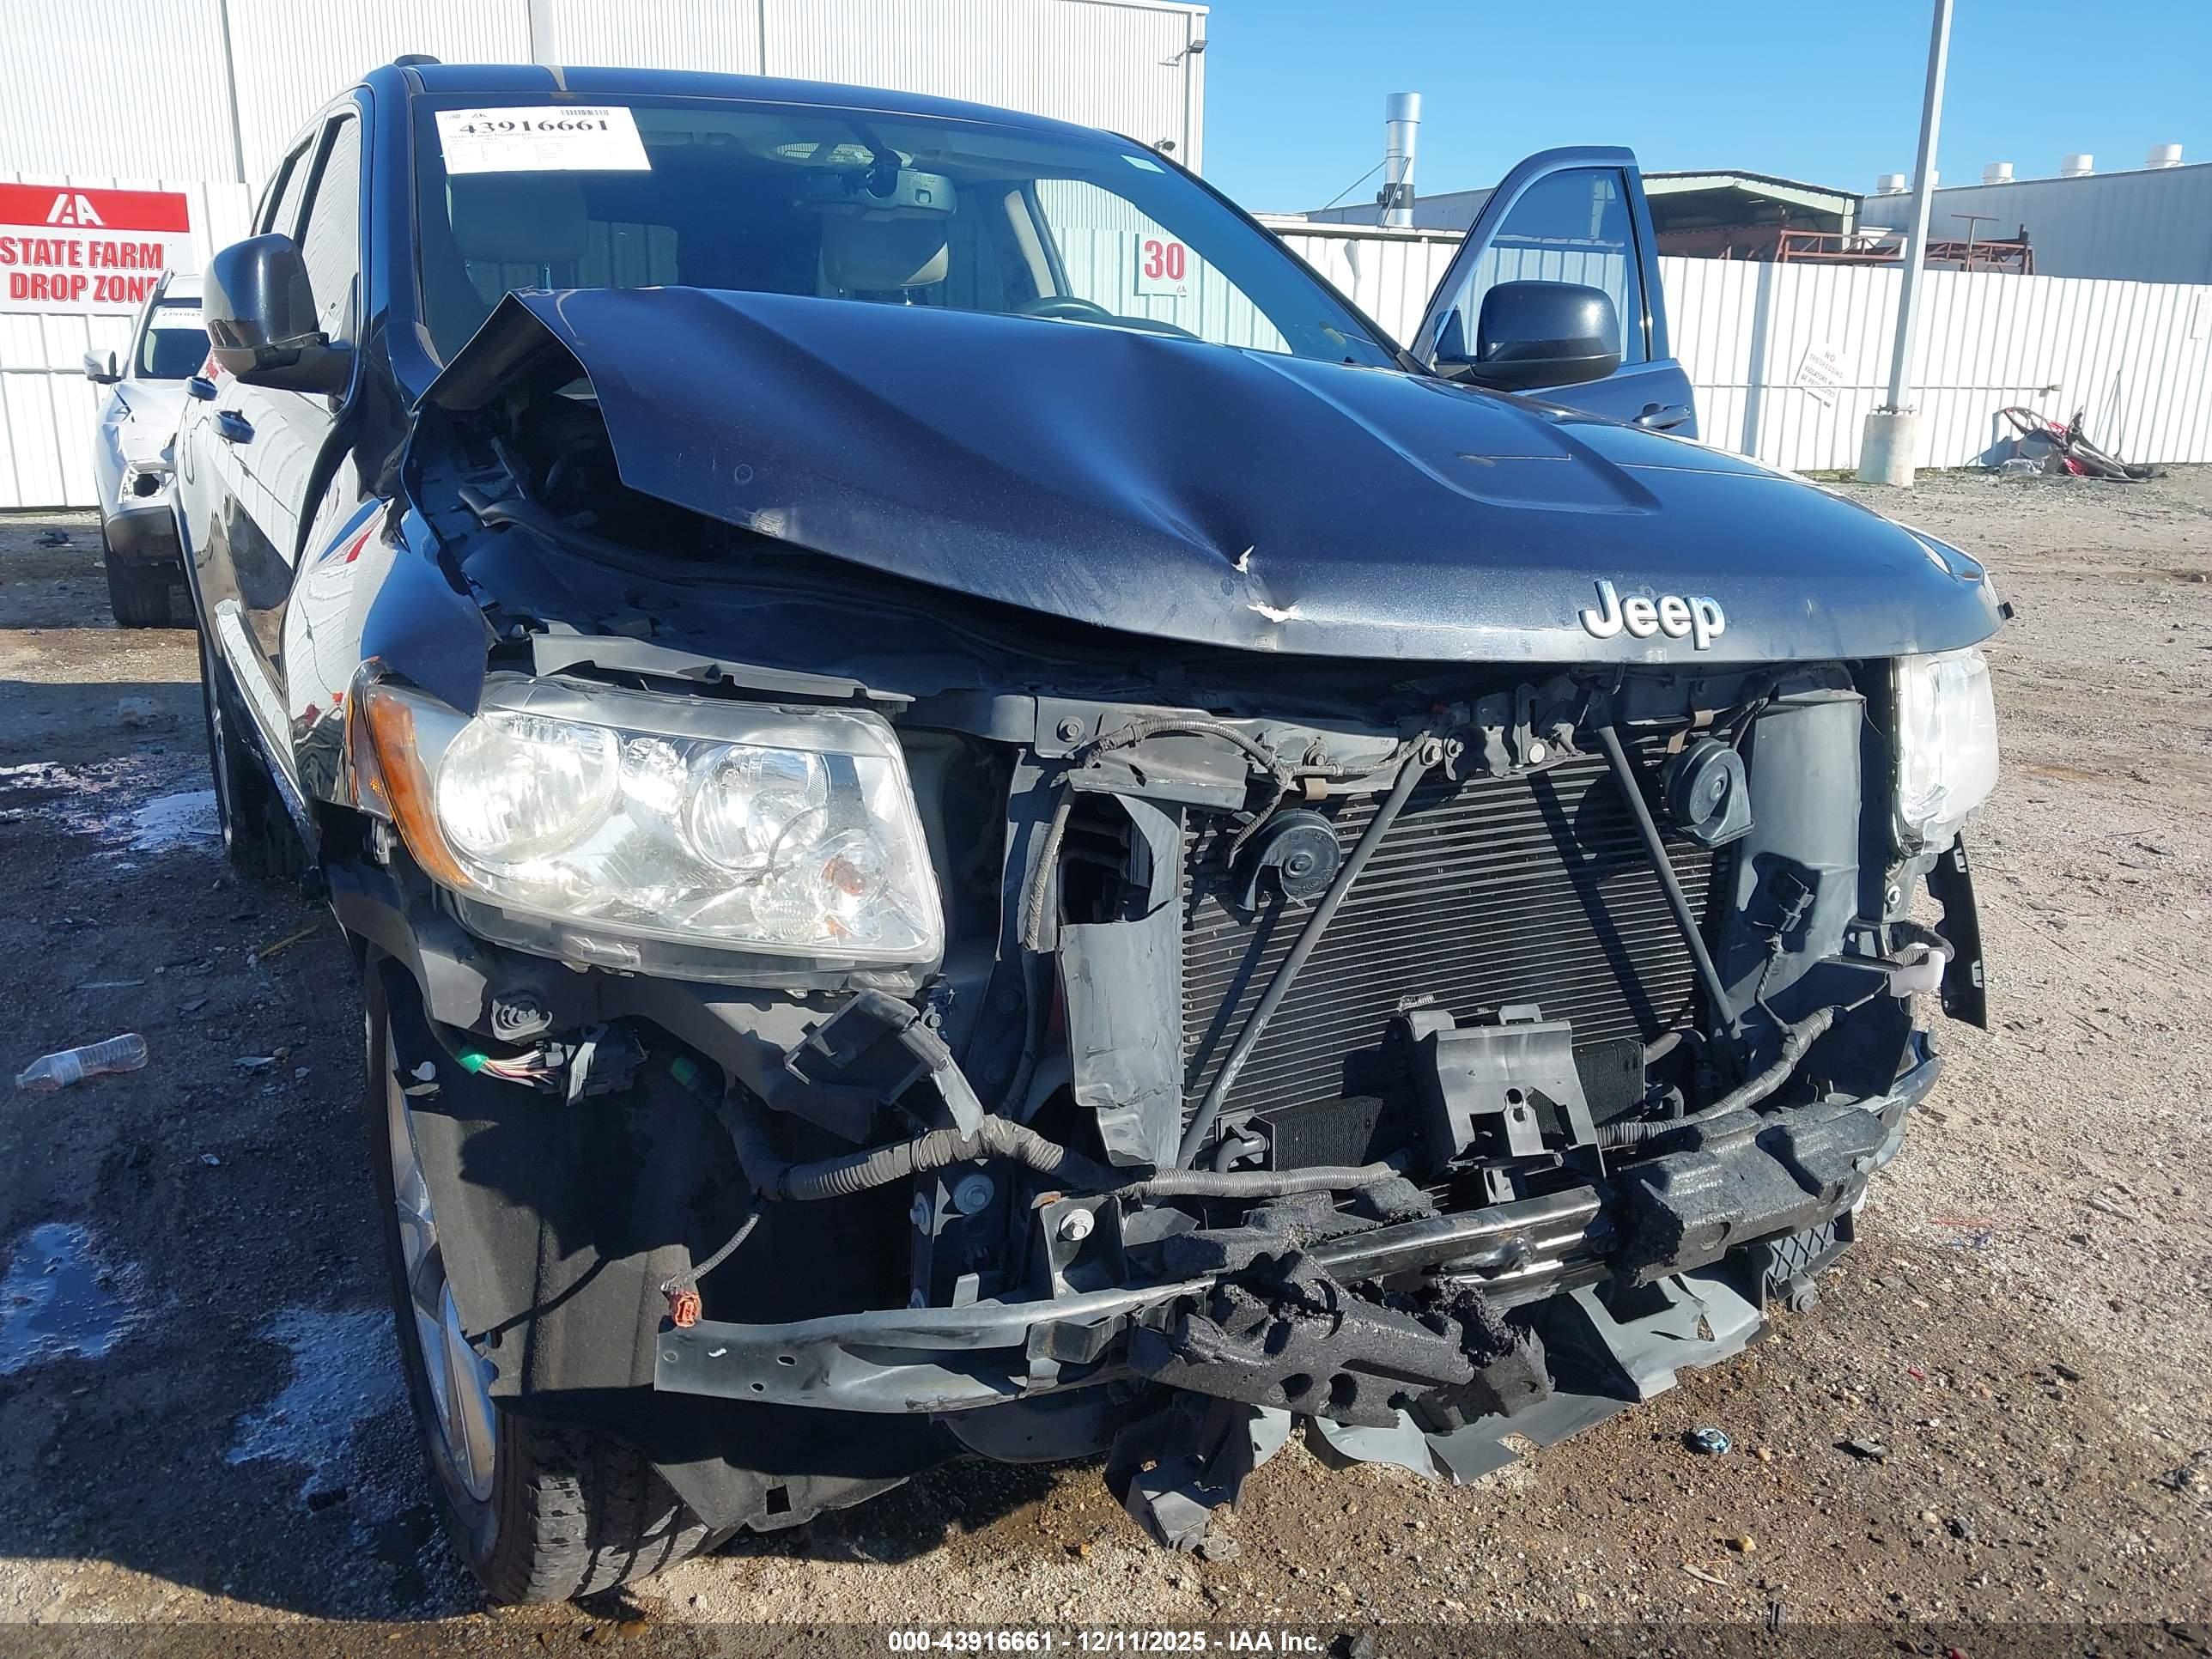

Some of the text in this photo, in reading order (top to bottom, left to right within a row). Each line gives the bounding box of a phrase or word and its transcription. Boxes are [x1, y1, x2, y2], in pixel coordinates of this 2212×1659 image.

[459, 119, 610, 134] 43916661
[0, 236, 164, 270] STATE FARM
[1145, 240, 1185, 281] 30
[9, 272, 88, 301] DROP
[1824, 350, 1836, 362] NO
[1578, 579, 1725, 650] Jeep
